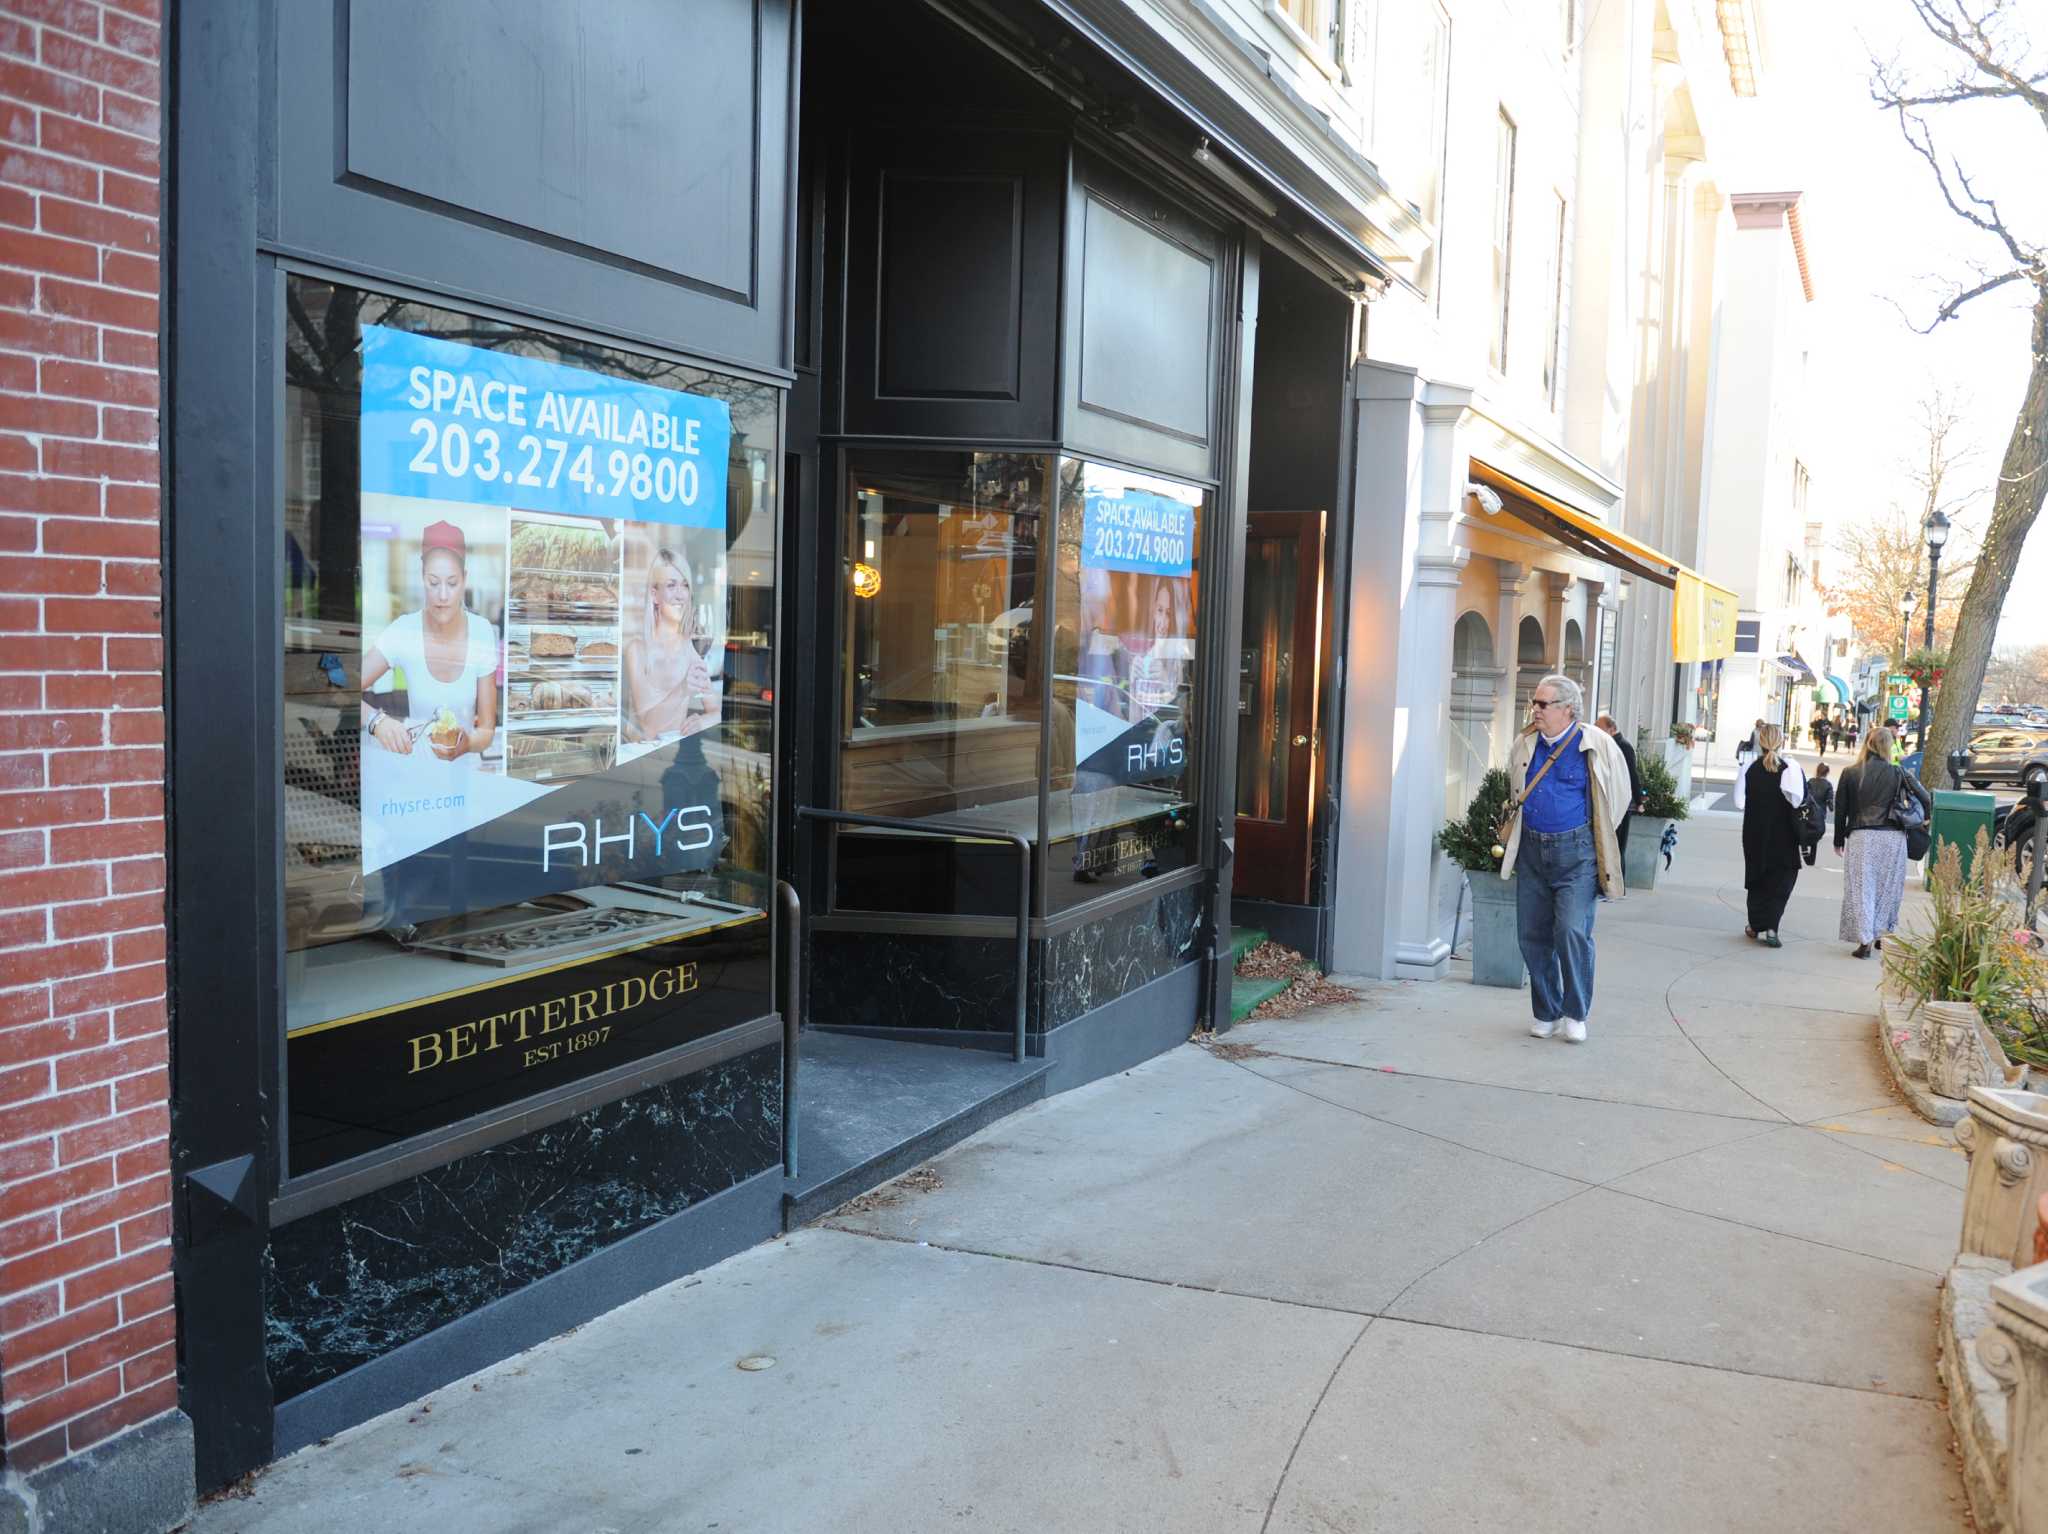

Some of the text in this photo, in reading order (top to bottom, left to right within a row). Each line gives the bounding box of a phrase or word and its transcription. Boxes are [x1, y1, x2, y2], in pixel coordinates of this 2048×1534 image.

[408, 366, 701, 456] SPACE AVAILABLE
[408, 418, 699, 506] 203.274.9800
[1096, 500, 1185, 536] SPACE AVAILABLE
[1094, 527, 1184, 565] 203.274.9800
[1127, 737, 1183, 773] RHYS
[381, 793, 466, 817] rhysre.com
[543, 804, 714, 873] RHYS
[407, 961, 699, 1074] BETTERIDGE
[522, 1026, 613, 1068] EST 1897
